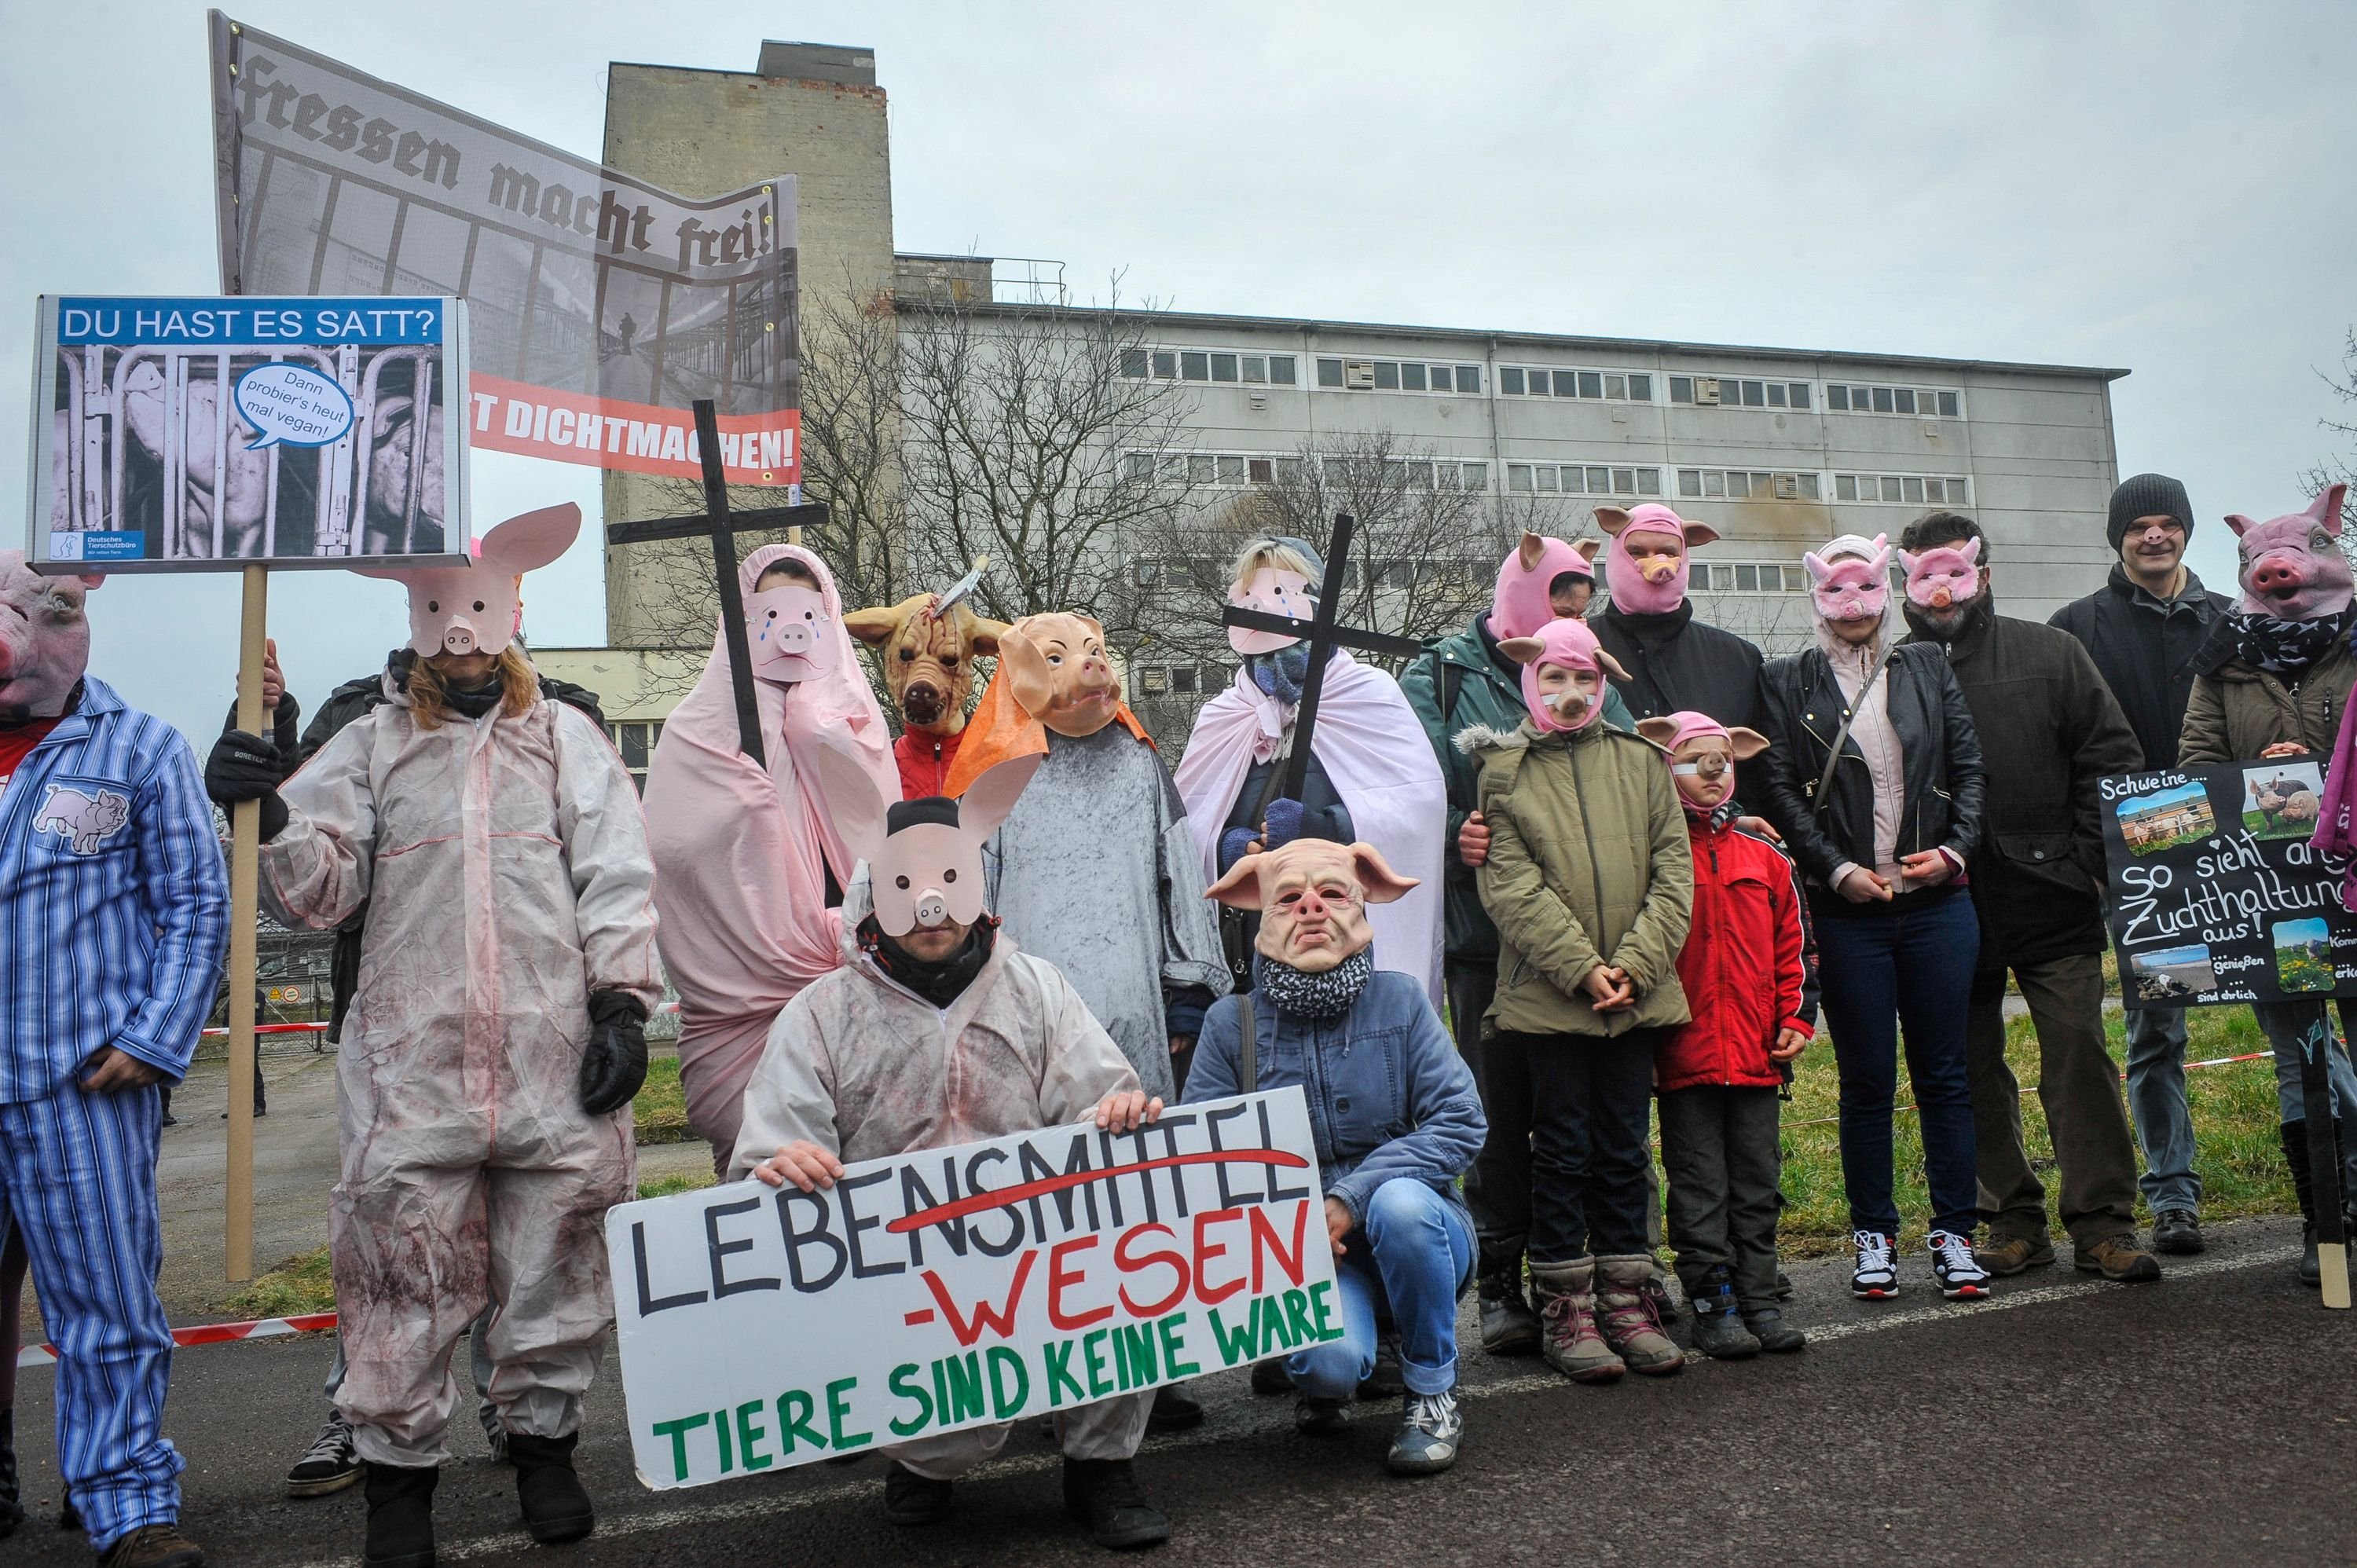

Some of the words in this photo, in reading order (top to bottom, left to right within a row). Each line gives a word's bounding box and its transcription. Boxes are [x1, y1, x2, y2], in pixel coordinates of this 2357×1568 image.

[236, 54, 461, 190] fressen
[488, 163, 656, 254] macht
[676, 201, 771, 272] frei!
[64, 310, 119, 338] DU
[136, 310, 240, 338] HAST
[254, 310, 302, 338] ES
[316, 310, 434, 338] SATT?
[284, 372, 323, 395] Dann
[246, 401, 273, 417] mal
[277, 412, 329, 438] vegan!
[312, 402, 345, 423] heut
[2122, 865, 2172, 900] So
[2196, 829, 2271, 877] sieht
[2202, 912, 2263, 943] aus!
[2214, 955, 2264, 975] genießen
[2197, 992, 2219, 1002] sind
[2221, 990, 2257, 1001] ehrlich
[632, 1100, 1310, 1317] LEBENSMITTEL
[904, 1200, 1310, 1346] -WESEN
[652, 1376, 874, 1482] TIERE
[889, 1345, 1030, 1436] SIND
[1043, 1311, 1200, 1409] KEINE
[1208, 1280, 1343, 1368] WARE
